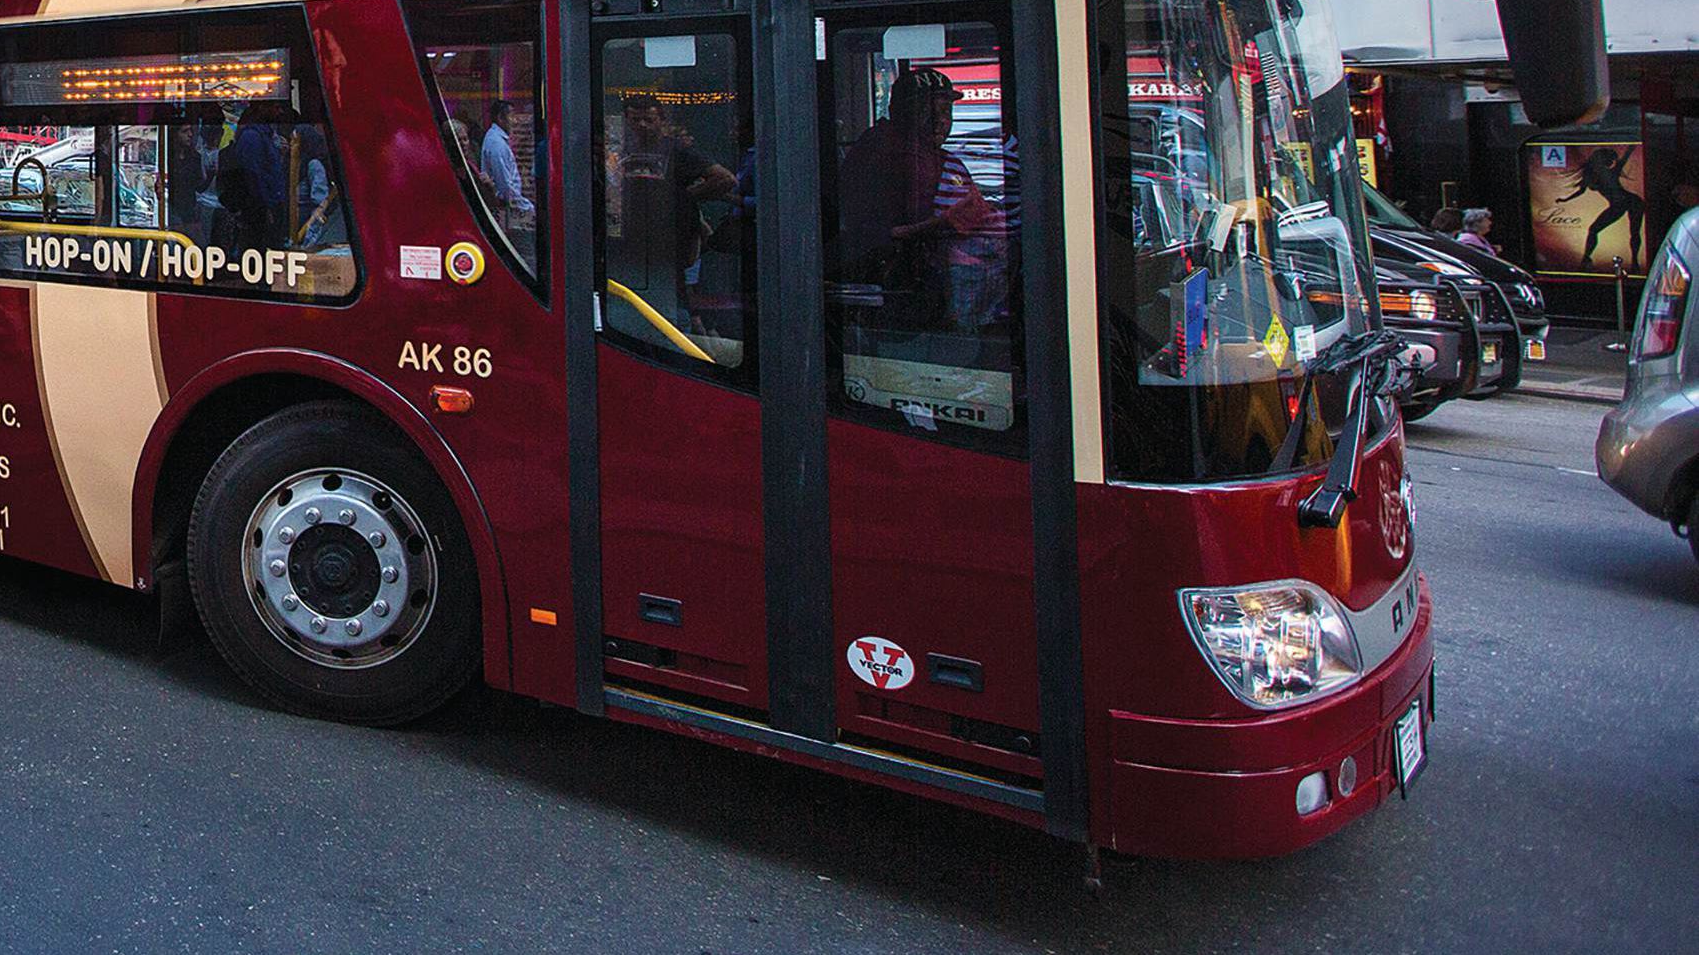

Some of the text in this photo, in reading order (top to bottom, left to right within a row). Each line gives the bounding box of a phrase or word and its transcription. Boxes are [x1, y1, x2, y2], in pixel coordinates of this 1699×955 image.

[25, 236, 130, 273] HOP-ON
[161, 242, 308, 287] HOP-OFF
[397, 340, 493, 378] AK 86
[859, 659, 903, 677] VECTOR
